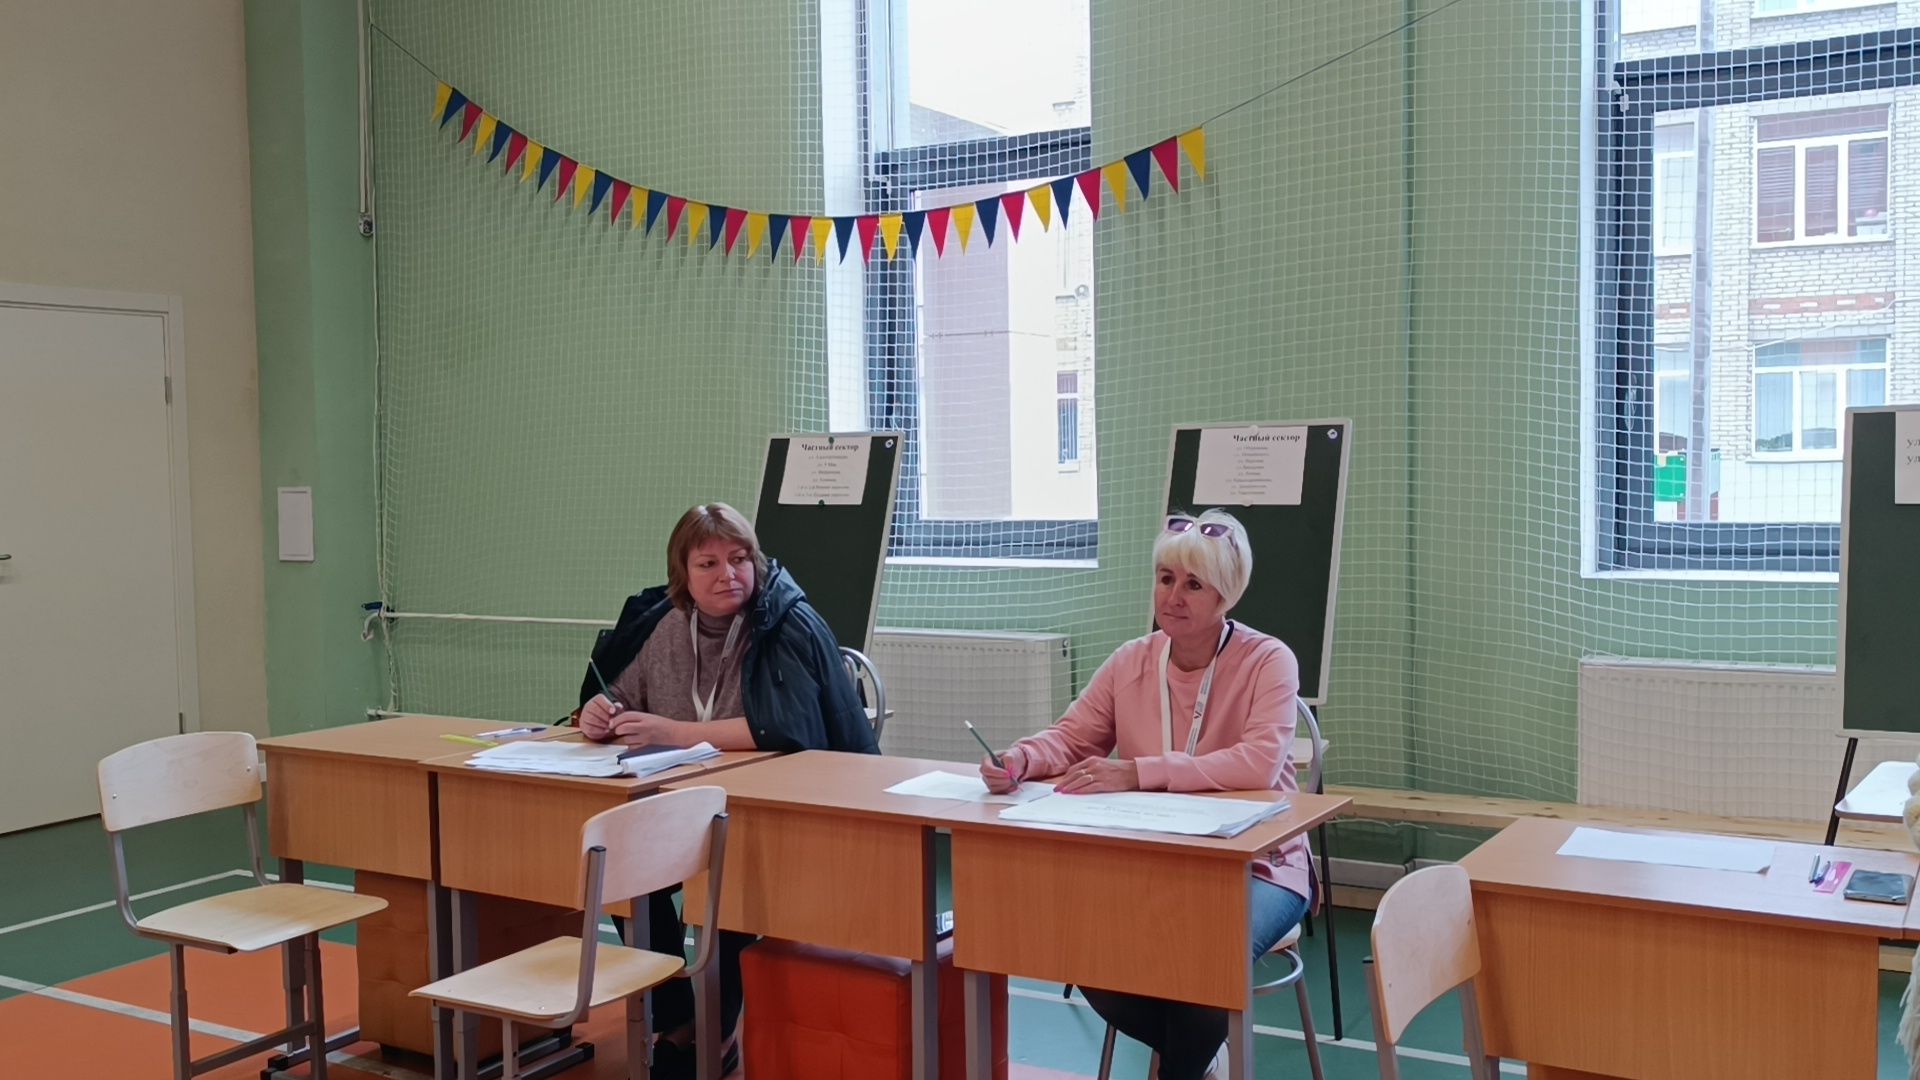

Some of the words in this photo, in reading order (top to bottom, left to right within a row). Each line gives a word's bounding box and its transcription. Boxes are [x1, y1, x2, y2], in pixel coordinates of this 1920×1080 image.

[1233, 433, 1270, 443] Частный
[1272, 434, 1301, 443] сектор
[835, 445, 860, 453] сектор
